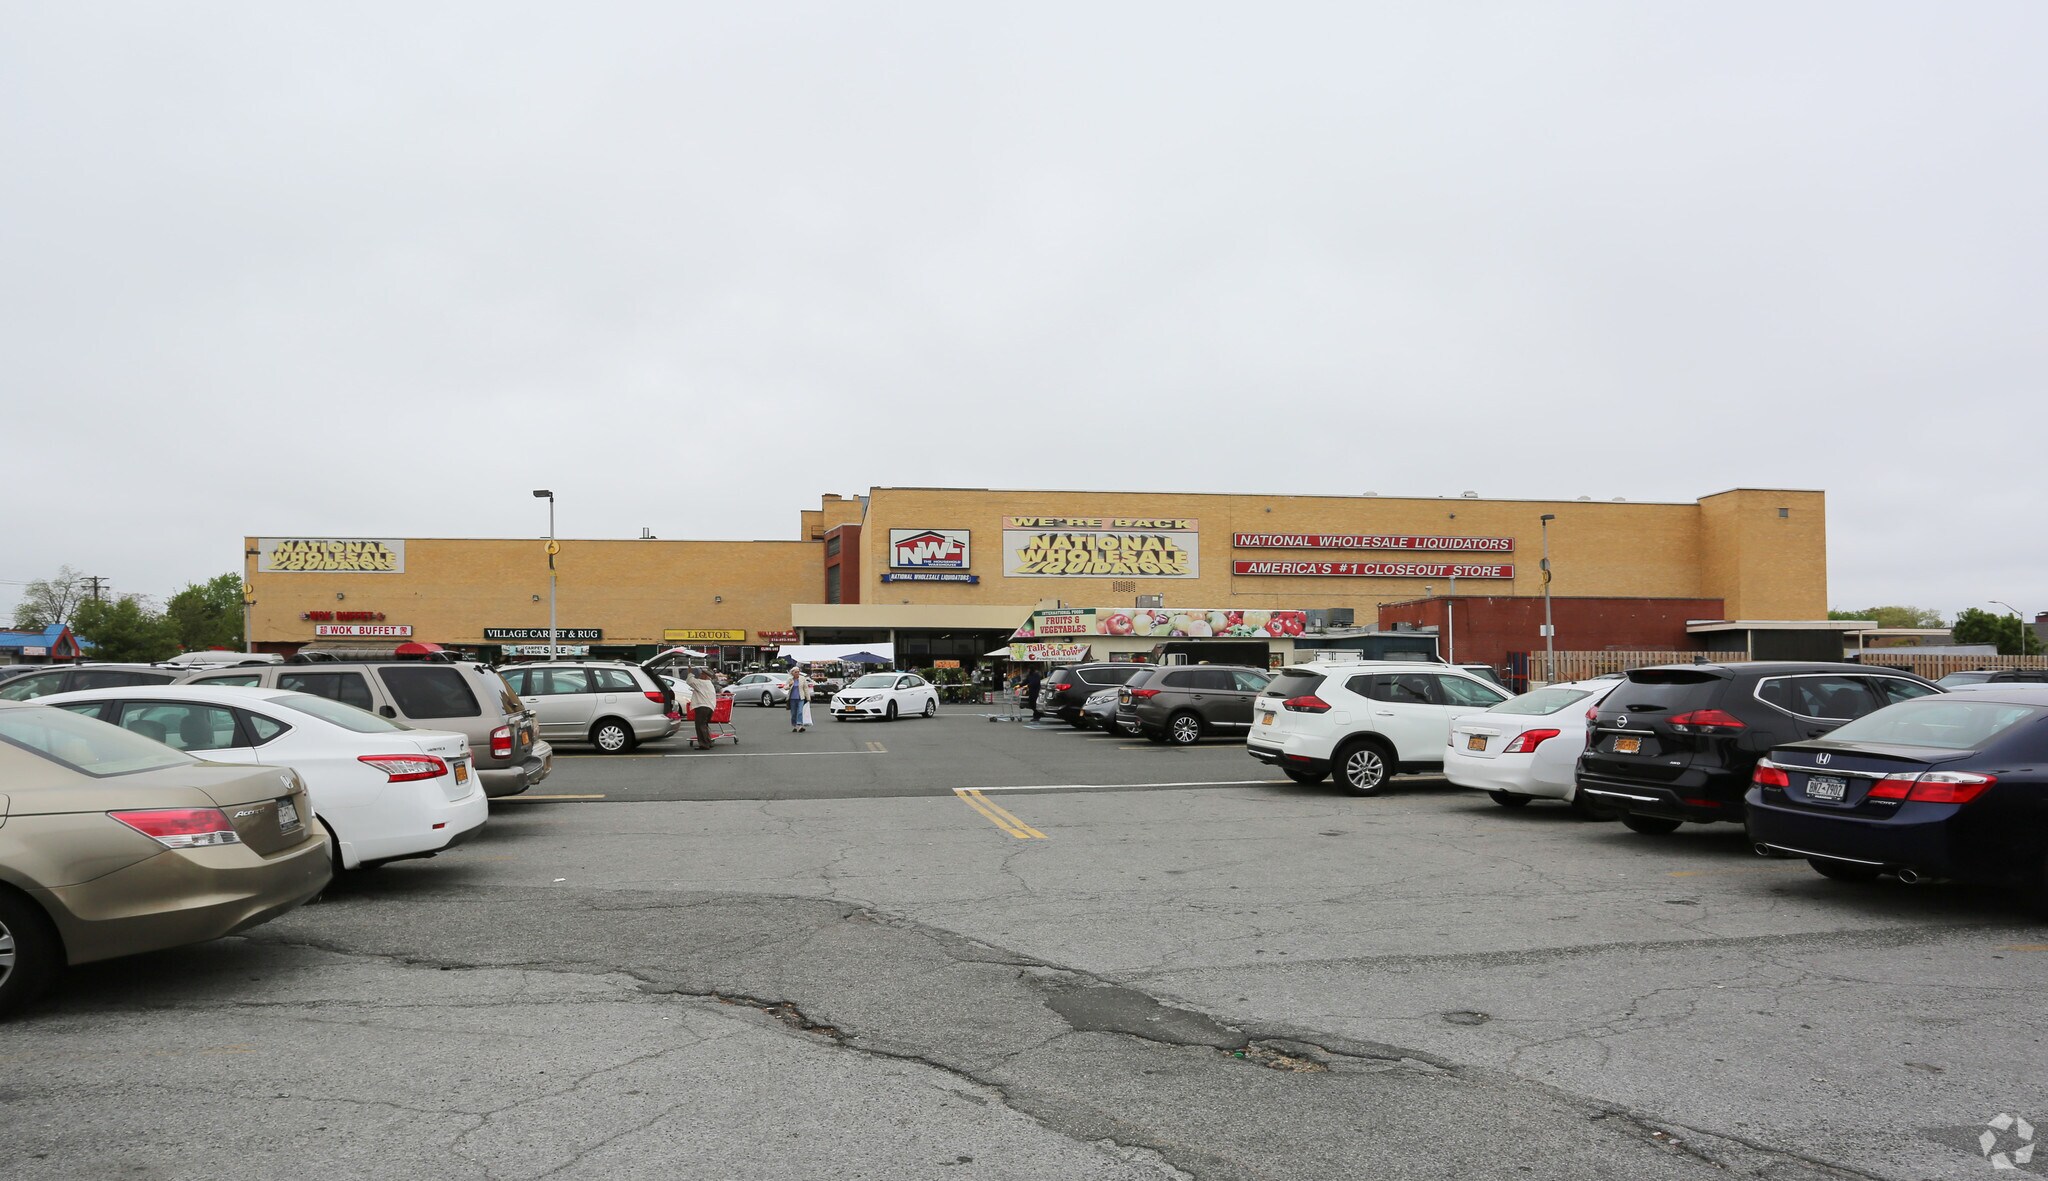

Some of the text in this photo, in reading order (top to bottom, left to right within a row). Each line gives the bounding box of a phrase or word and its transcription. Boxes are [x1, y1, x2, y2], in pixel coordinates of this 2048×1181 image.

[1010, 517, 1193, 530] WE'RE BACK
[276, 541, 390, 552] NATIONAL
[1028, 534, 1179, 551] NATIONAL
[1239, 534, 1509, 550] NATIONAL WHOLESALE LIQUIDATORS
[900, 536, 961, 565] NWL
[268, 551, 397, 563] WHOLESALE
[1016, 549, 1189, 564] WHOLESALE
[266, 560, 398, 571] LIQUIDATORS
[1013, 561, 1193, 575] LIQUIDATORS
[1247, 563, 1332, 574] AMERICA'S
[1364, 564, 1447, 576] CLOSEOUT
[1452, 565, 1501, 577] STORE
[310, 611, 374, 622] WOK BUFFET
[1045, 615, 1080, 625] FRUITS &
[330, 626, 353, 635] WOK
[359, 626, 397, 635] BUFFET
[487, 629, 528, 638] VILLAGE
[568, 630, 576, 638] &
[577, 630, 598, 638] RUG
[687, 631, 731, 639] LIQUOR
[1040, 625, 1087, 634] VEGETABLES
[543, 646, 567, 654] SLE
[1027, 643, 1046, 652] Talk
[1041, 649, 1049, 657] of
[1051, 648, 1060, 657] da
